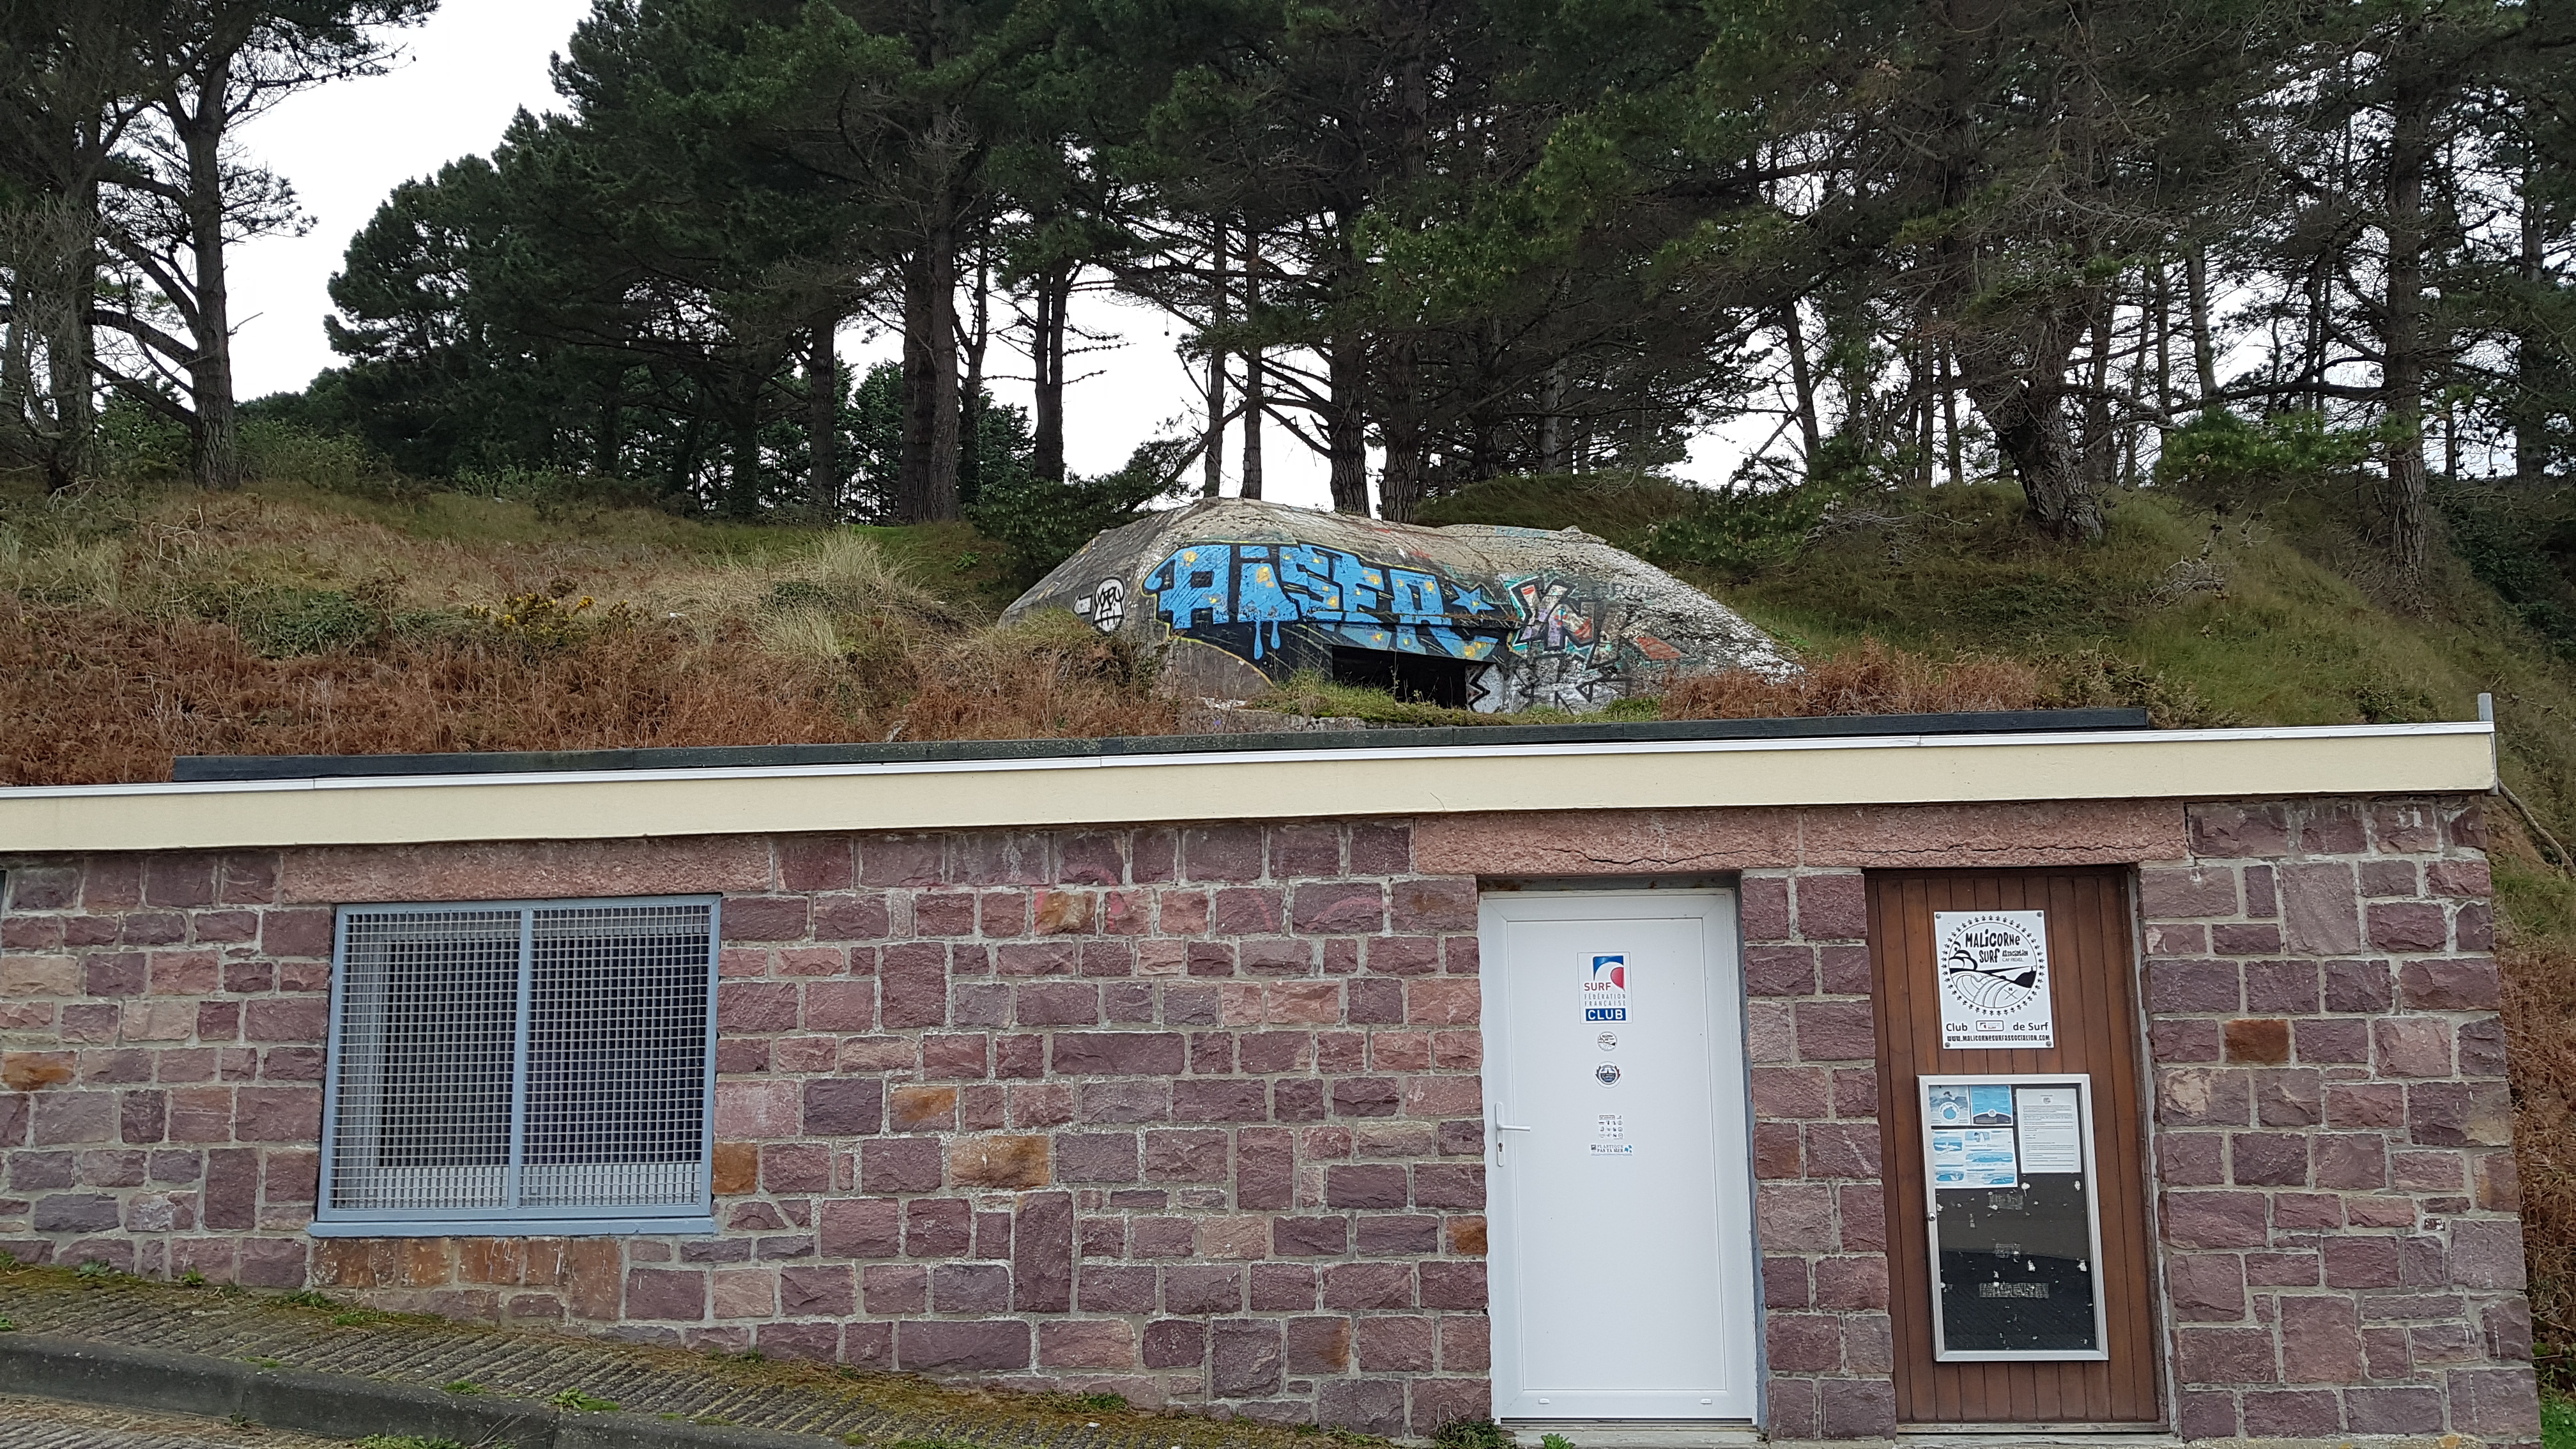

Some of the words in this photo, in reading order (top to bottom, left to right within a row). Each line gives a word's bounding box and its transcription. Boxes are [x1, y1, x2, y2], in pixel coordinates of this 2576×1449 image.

[1584, 982, 1612, 992] SURF
[1588, 1009, 1624, 1020] CLUB
[1945, 1022, 1968, 1032] Club
[2012, 1022, 2025, 1031] de
[2028, 1022, 2049, 1031] Surf
